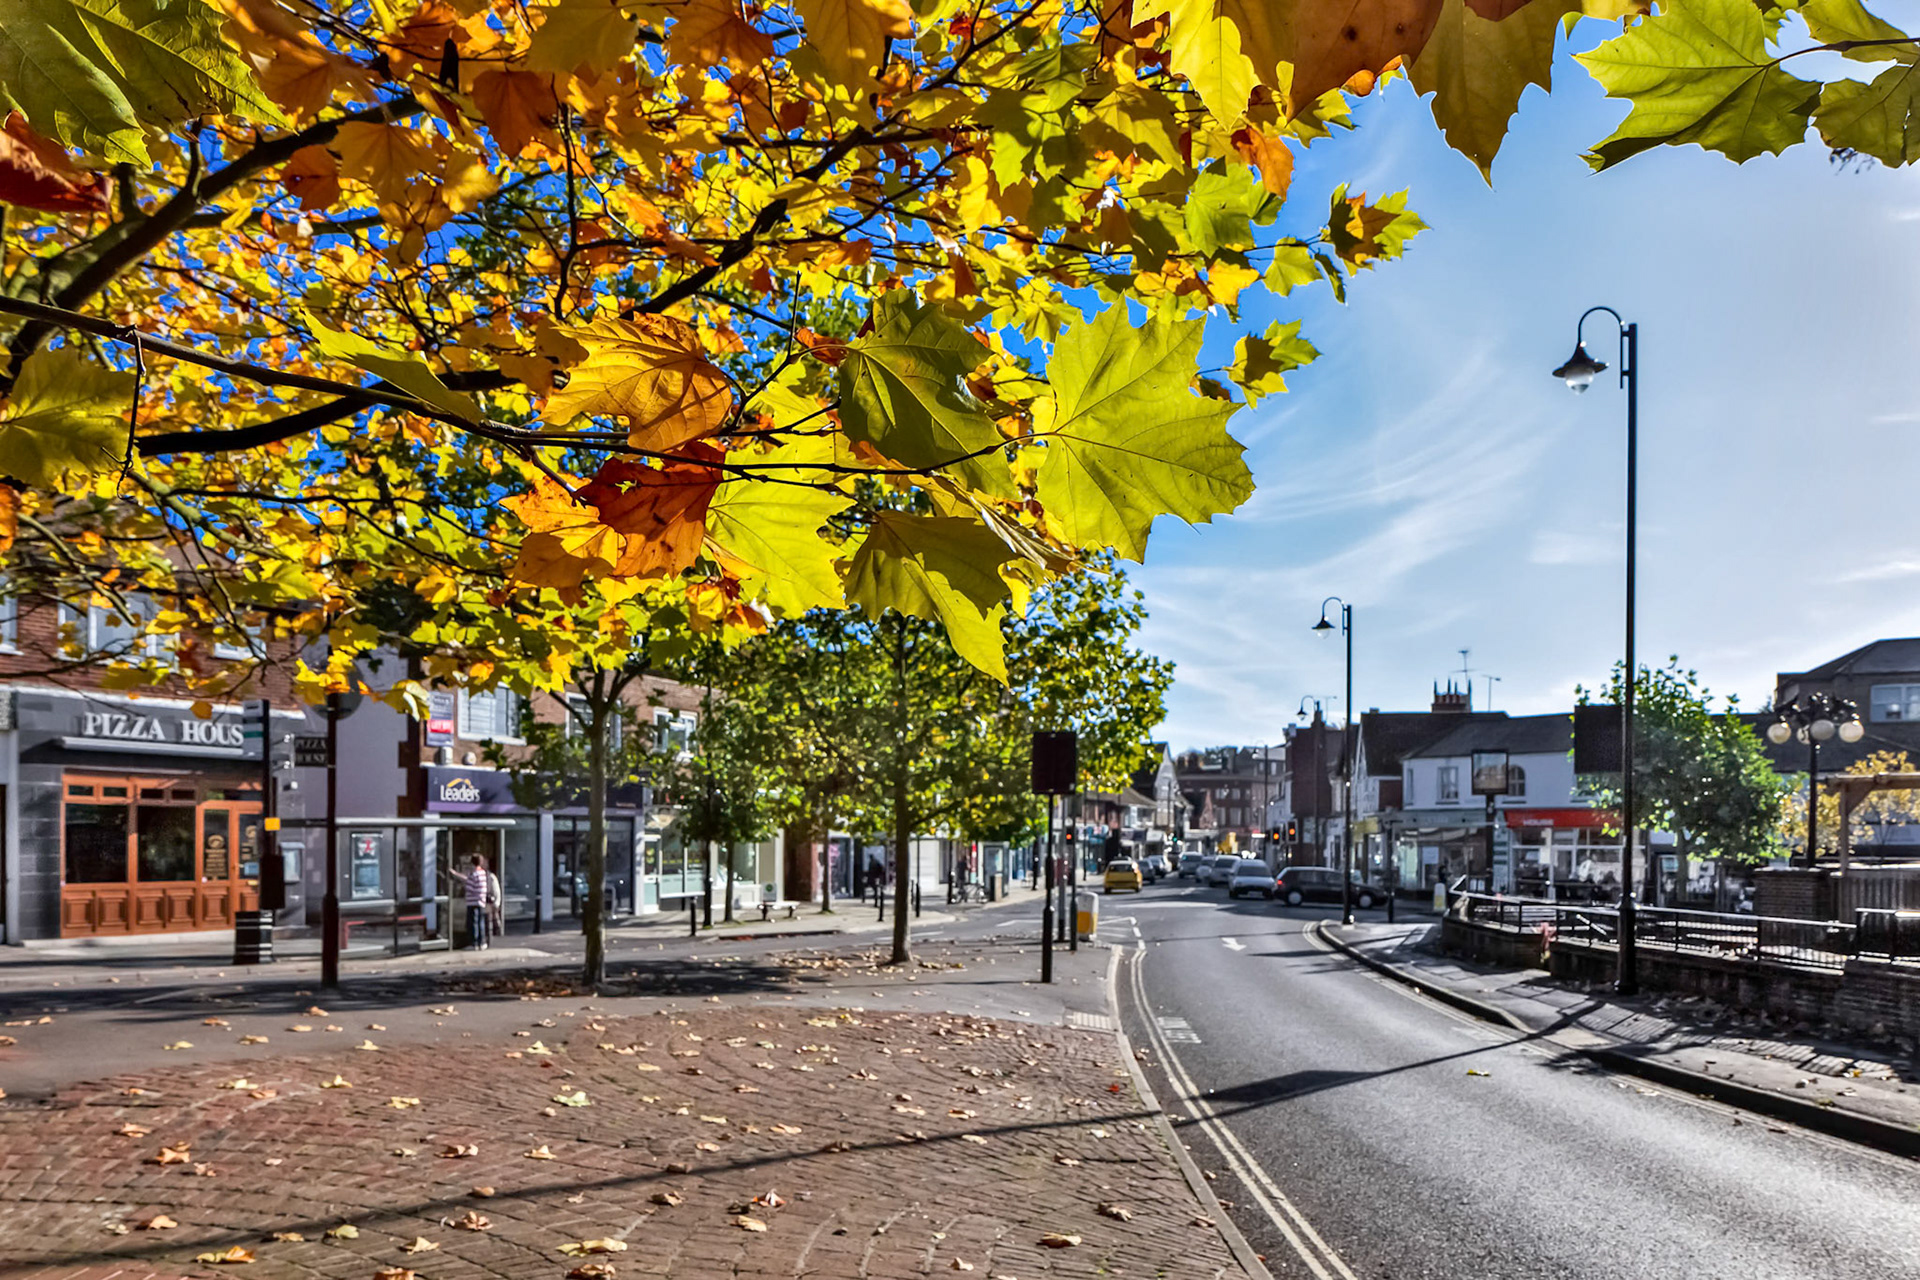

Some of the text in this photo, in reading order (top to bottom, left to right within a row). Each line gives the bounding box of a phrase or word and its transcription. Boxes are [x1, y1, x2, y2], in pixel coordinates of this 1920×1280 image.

[83, 711, 245, 747] PIZZA HOUS
[440, 784, 480, 803] Leaders
